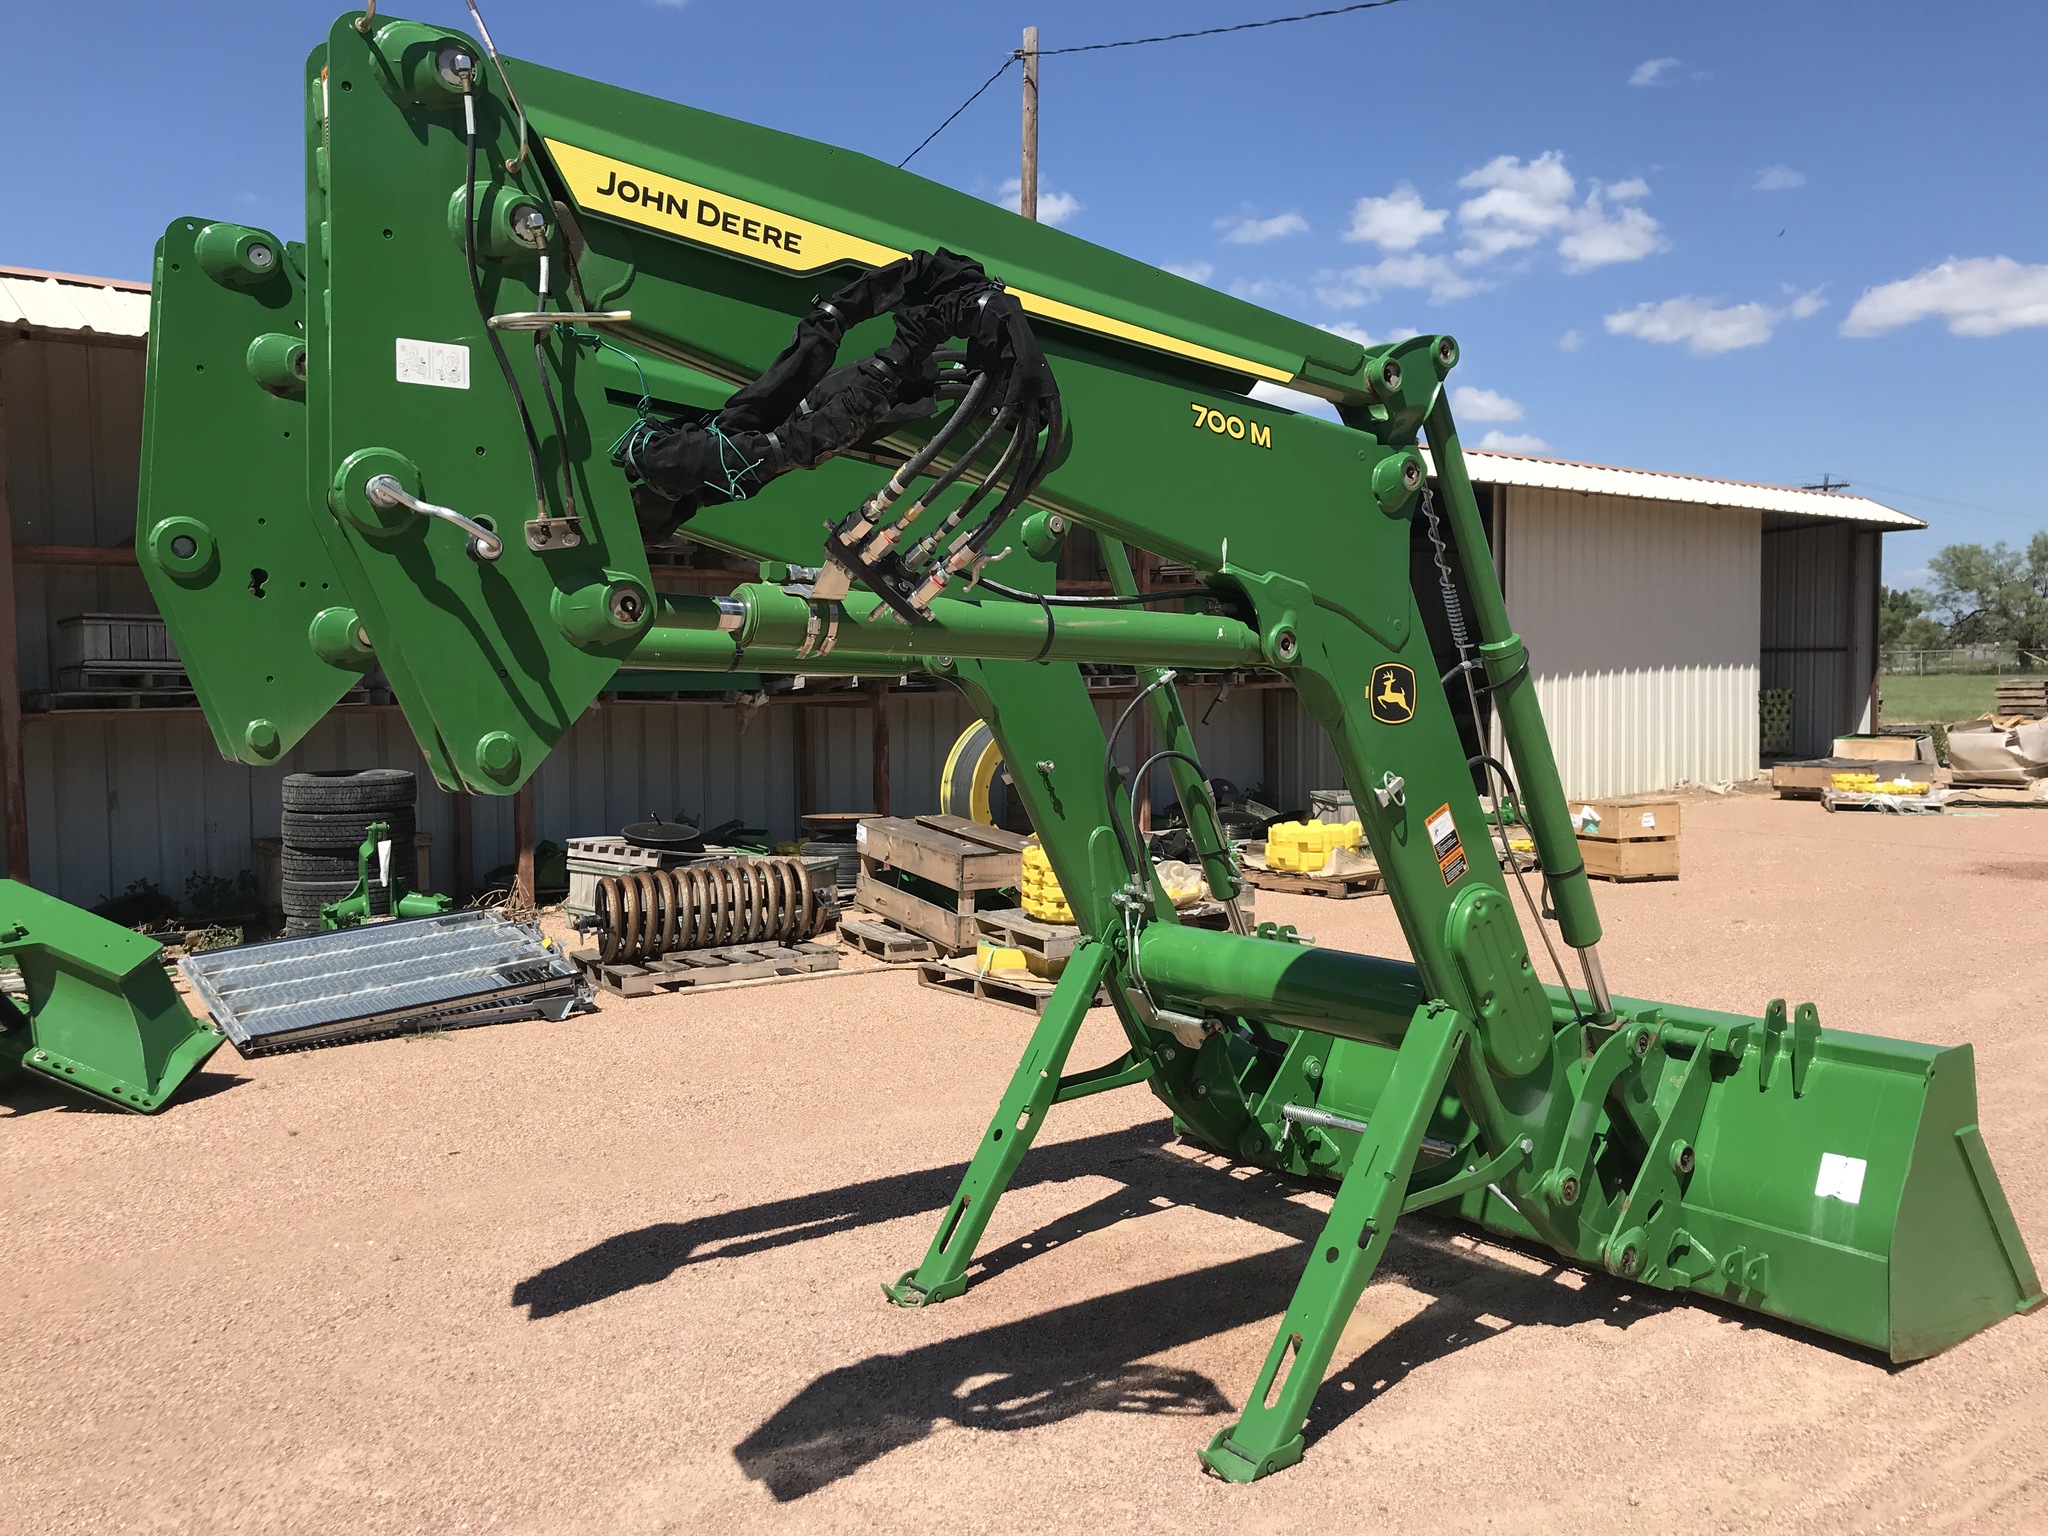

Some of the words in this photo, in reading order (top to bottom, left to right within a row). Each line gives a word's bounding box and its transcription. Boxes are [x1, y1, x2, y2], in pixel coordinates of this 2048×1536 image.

[596, 171, 688, 219] JOHN
[697, 199, 803, 255] DEERE
[1191, 402, 1246, 440] 700
[1250, 420, 1272, 450] M
